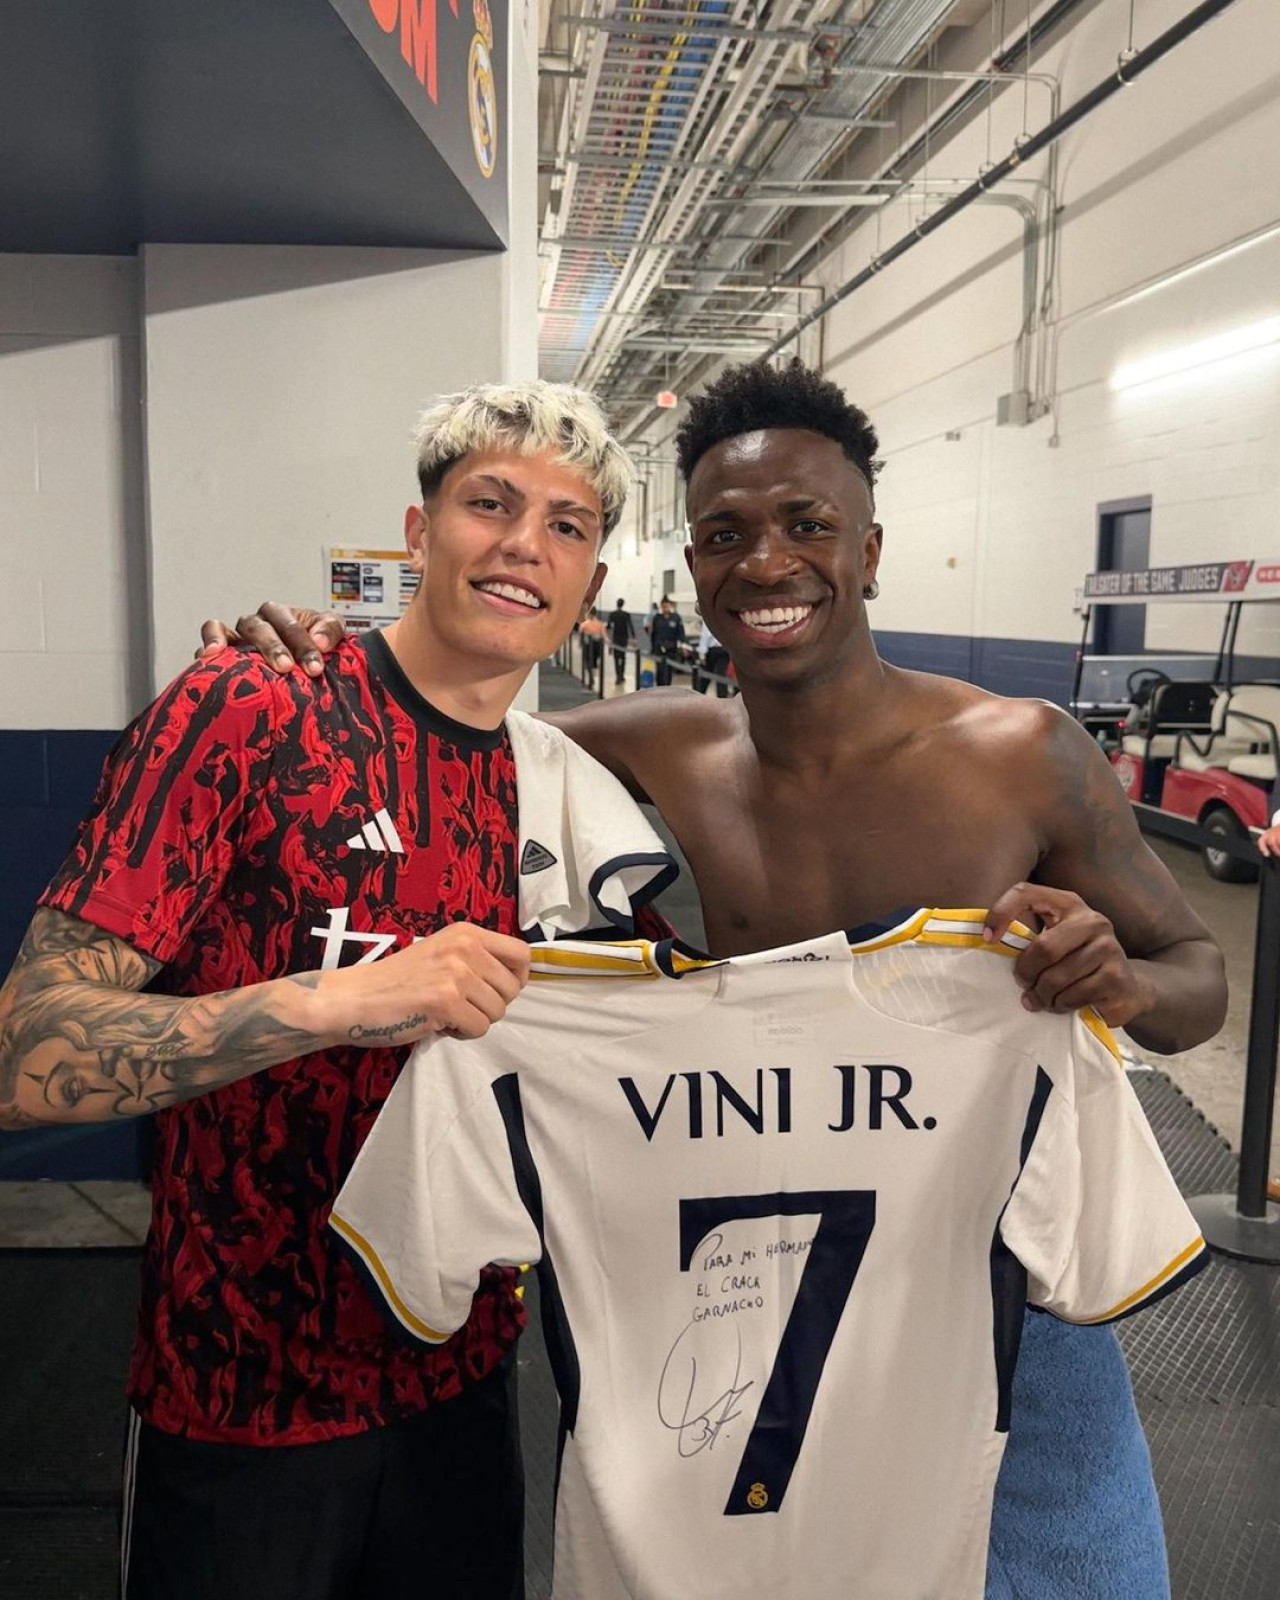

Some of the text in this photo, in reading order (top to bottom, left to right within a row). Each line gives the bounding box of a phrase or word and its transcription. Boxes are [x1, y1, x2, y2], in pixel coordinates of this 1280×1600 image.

[1151, 569, 1176, 592] GAME
[1178, 567, 1218, 590] JUDGES
[617, 1064, 937, 1143] VINI JR.
[697, 1283, 711, 1298] EL
[679, 1190, 876, 1516] 7
